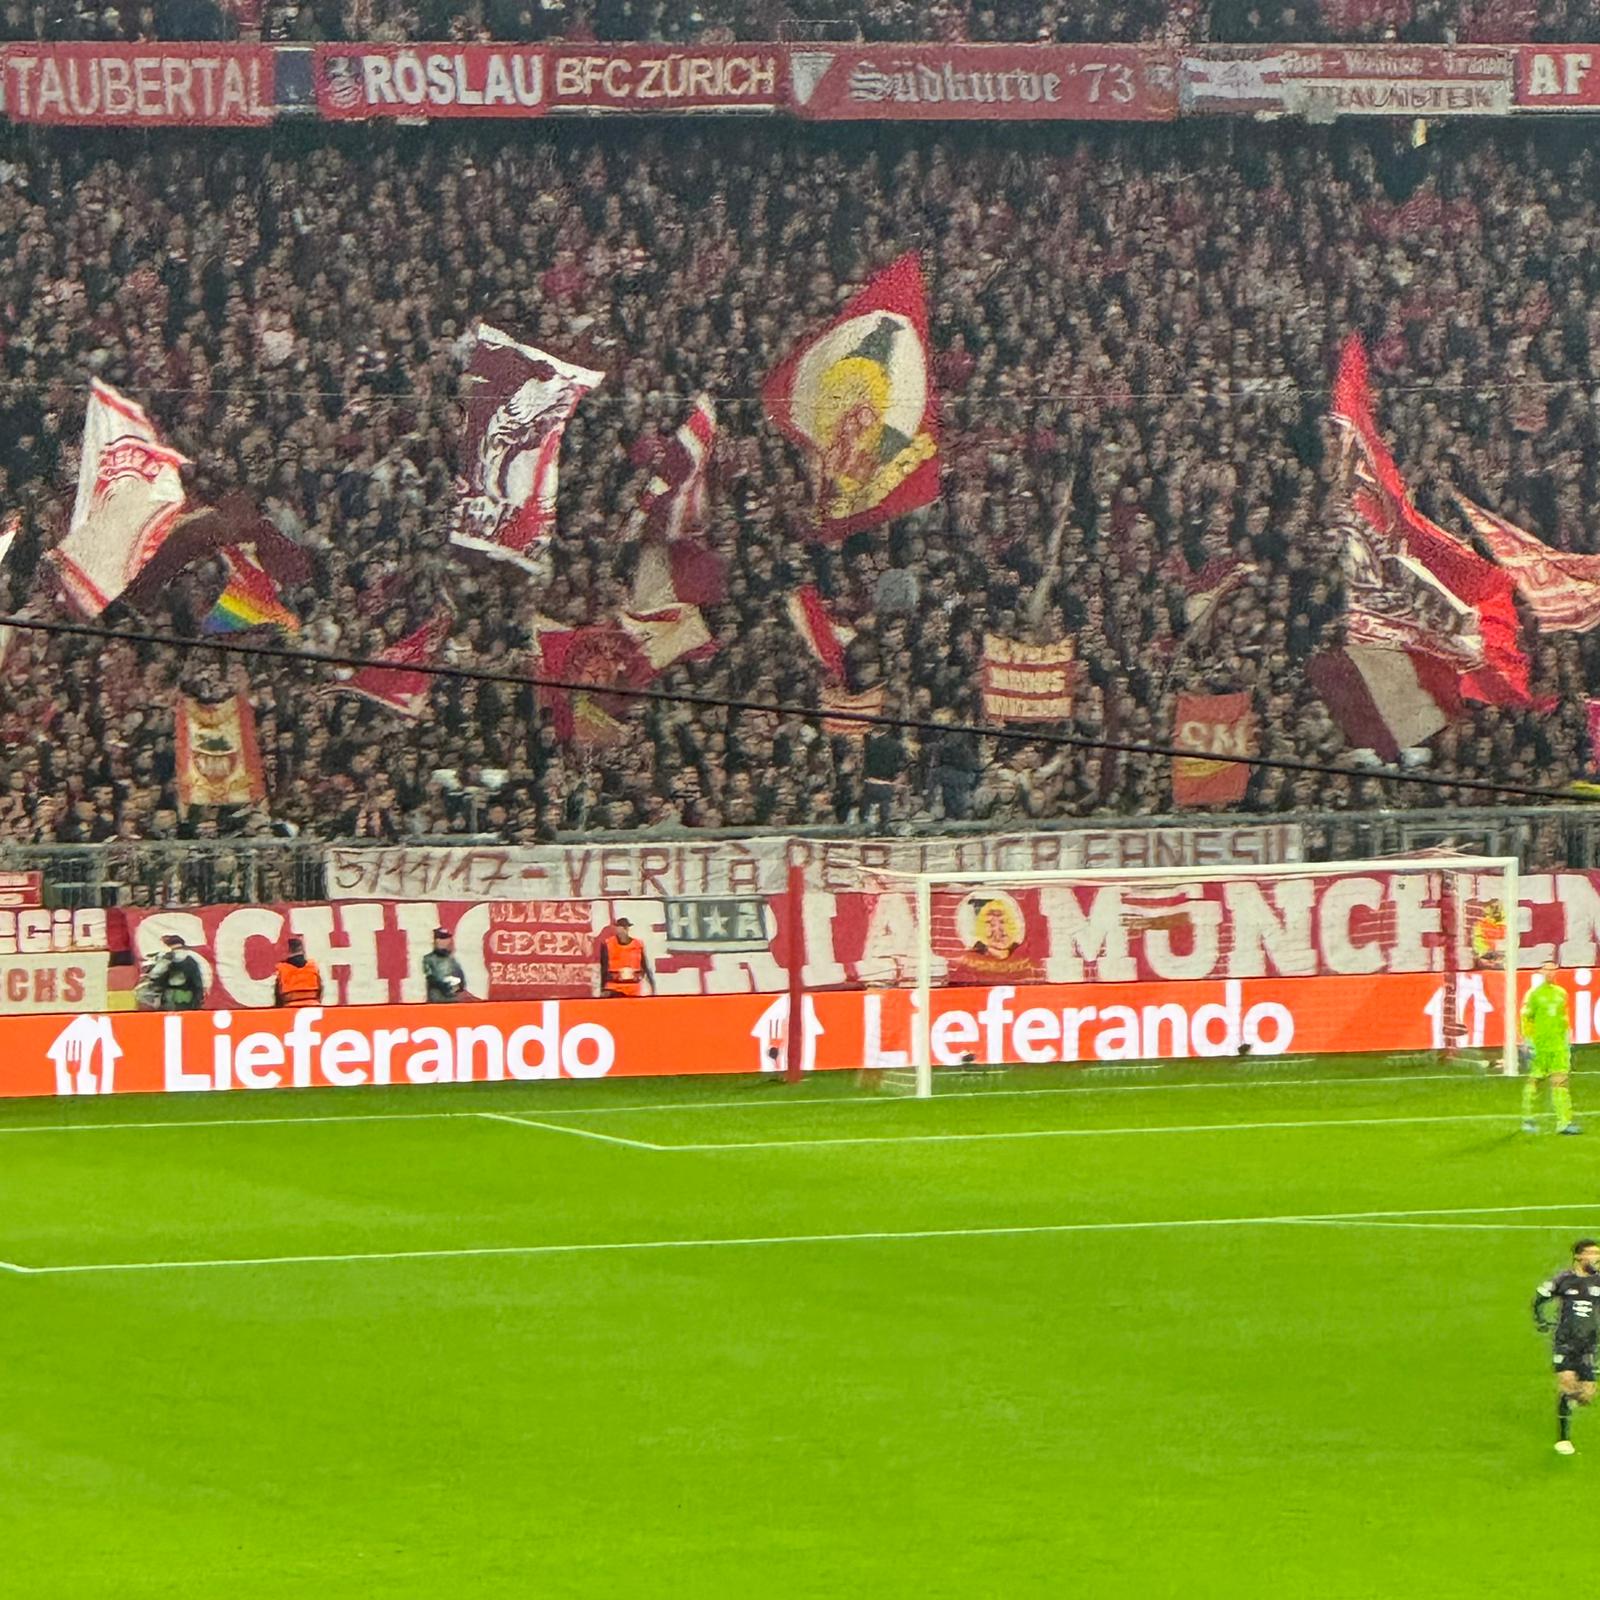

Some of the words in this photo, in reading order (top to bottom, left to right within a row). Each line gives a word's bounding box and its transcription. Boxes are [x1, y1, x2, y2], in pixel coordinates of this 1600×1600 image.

[7, 57, 271, 117] TAUBERTAL
[363, 49, 545, 106] RÖSLAU
[556, 56, 632, 96] BFC
[637, 54, 776, 98] ZÜRICH
[849, 60, 1062, 102] Südkurve
[164, 1001, 615, 1092] Lieferando
[863, 980, 1295, 1068] Lieferando
